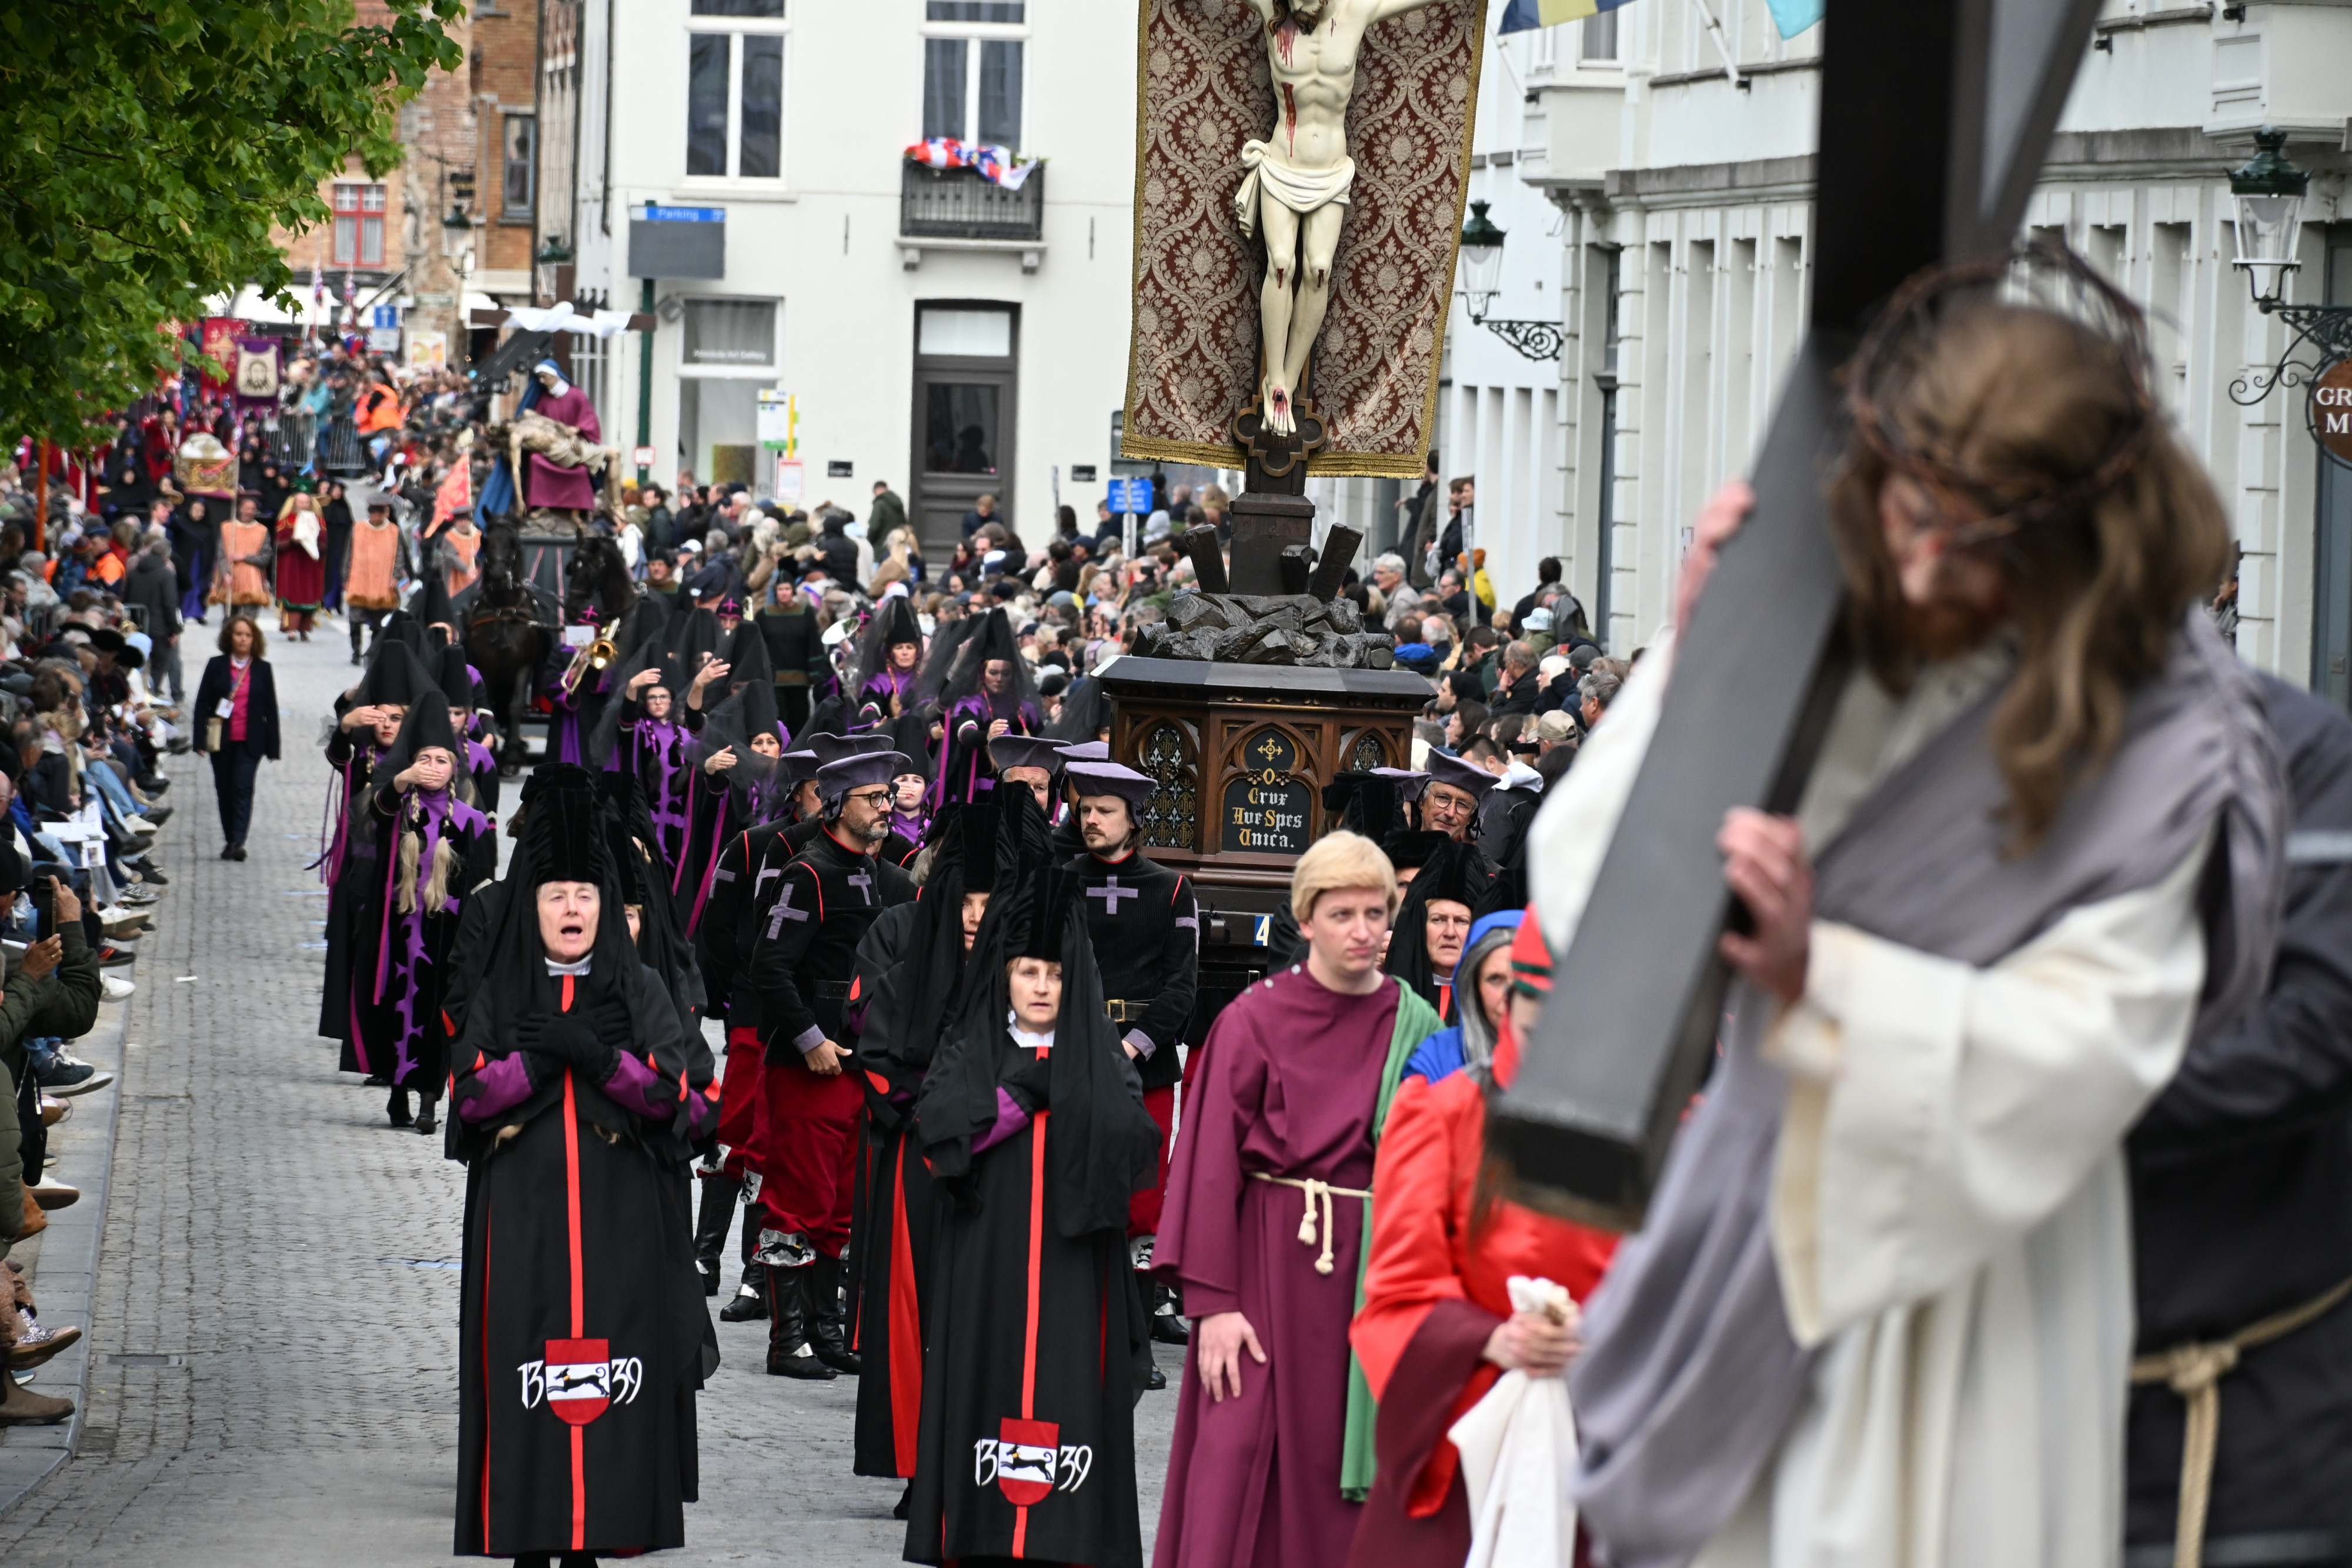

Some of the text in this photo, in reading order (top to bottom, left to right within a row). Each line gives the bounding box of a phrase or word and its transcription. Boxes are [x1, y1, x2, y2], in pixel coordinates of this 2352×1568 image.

[658, 208, 699, 222] Parking
[2325, 413, 2352, 434] M
[1262, 768, 1275, 785] O
[1264, 809, 1302, 833] Spes
[1255, 915, 1270, 946] 4
[517, 1357, 642, 1410] 13 39
[974, 1439, 1093, 1493] 13 39
